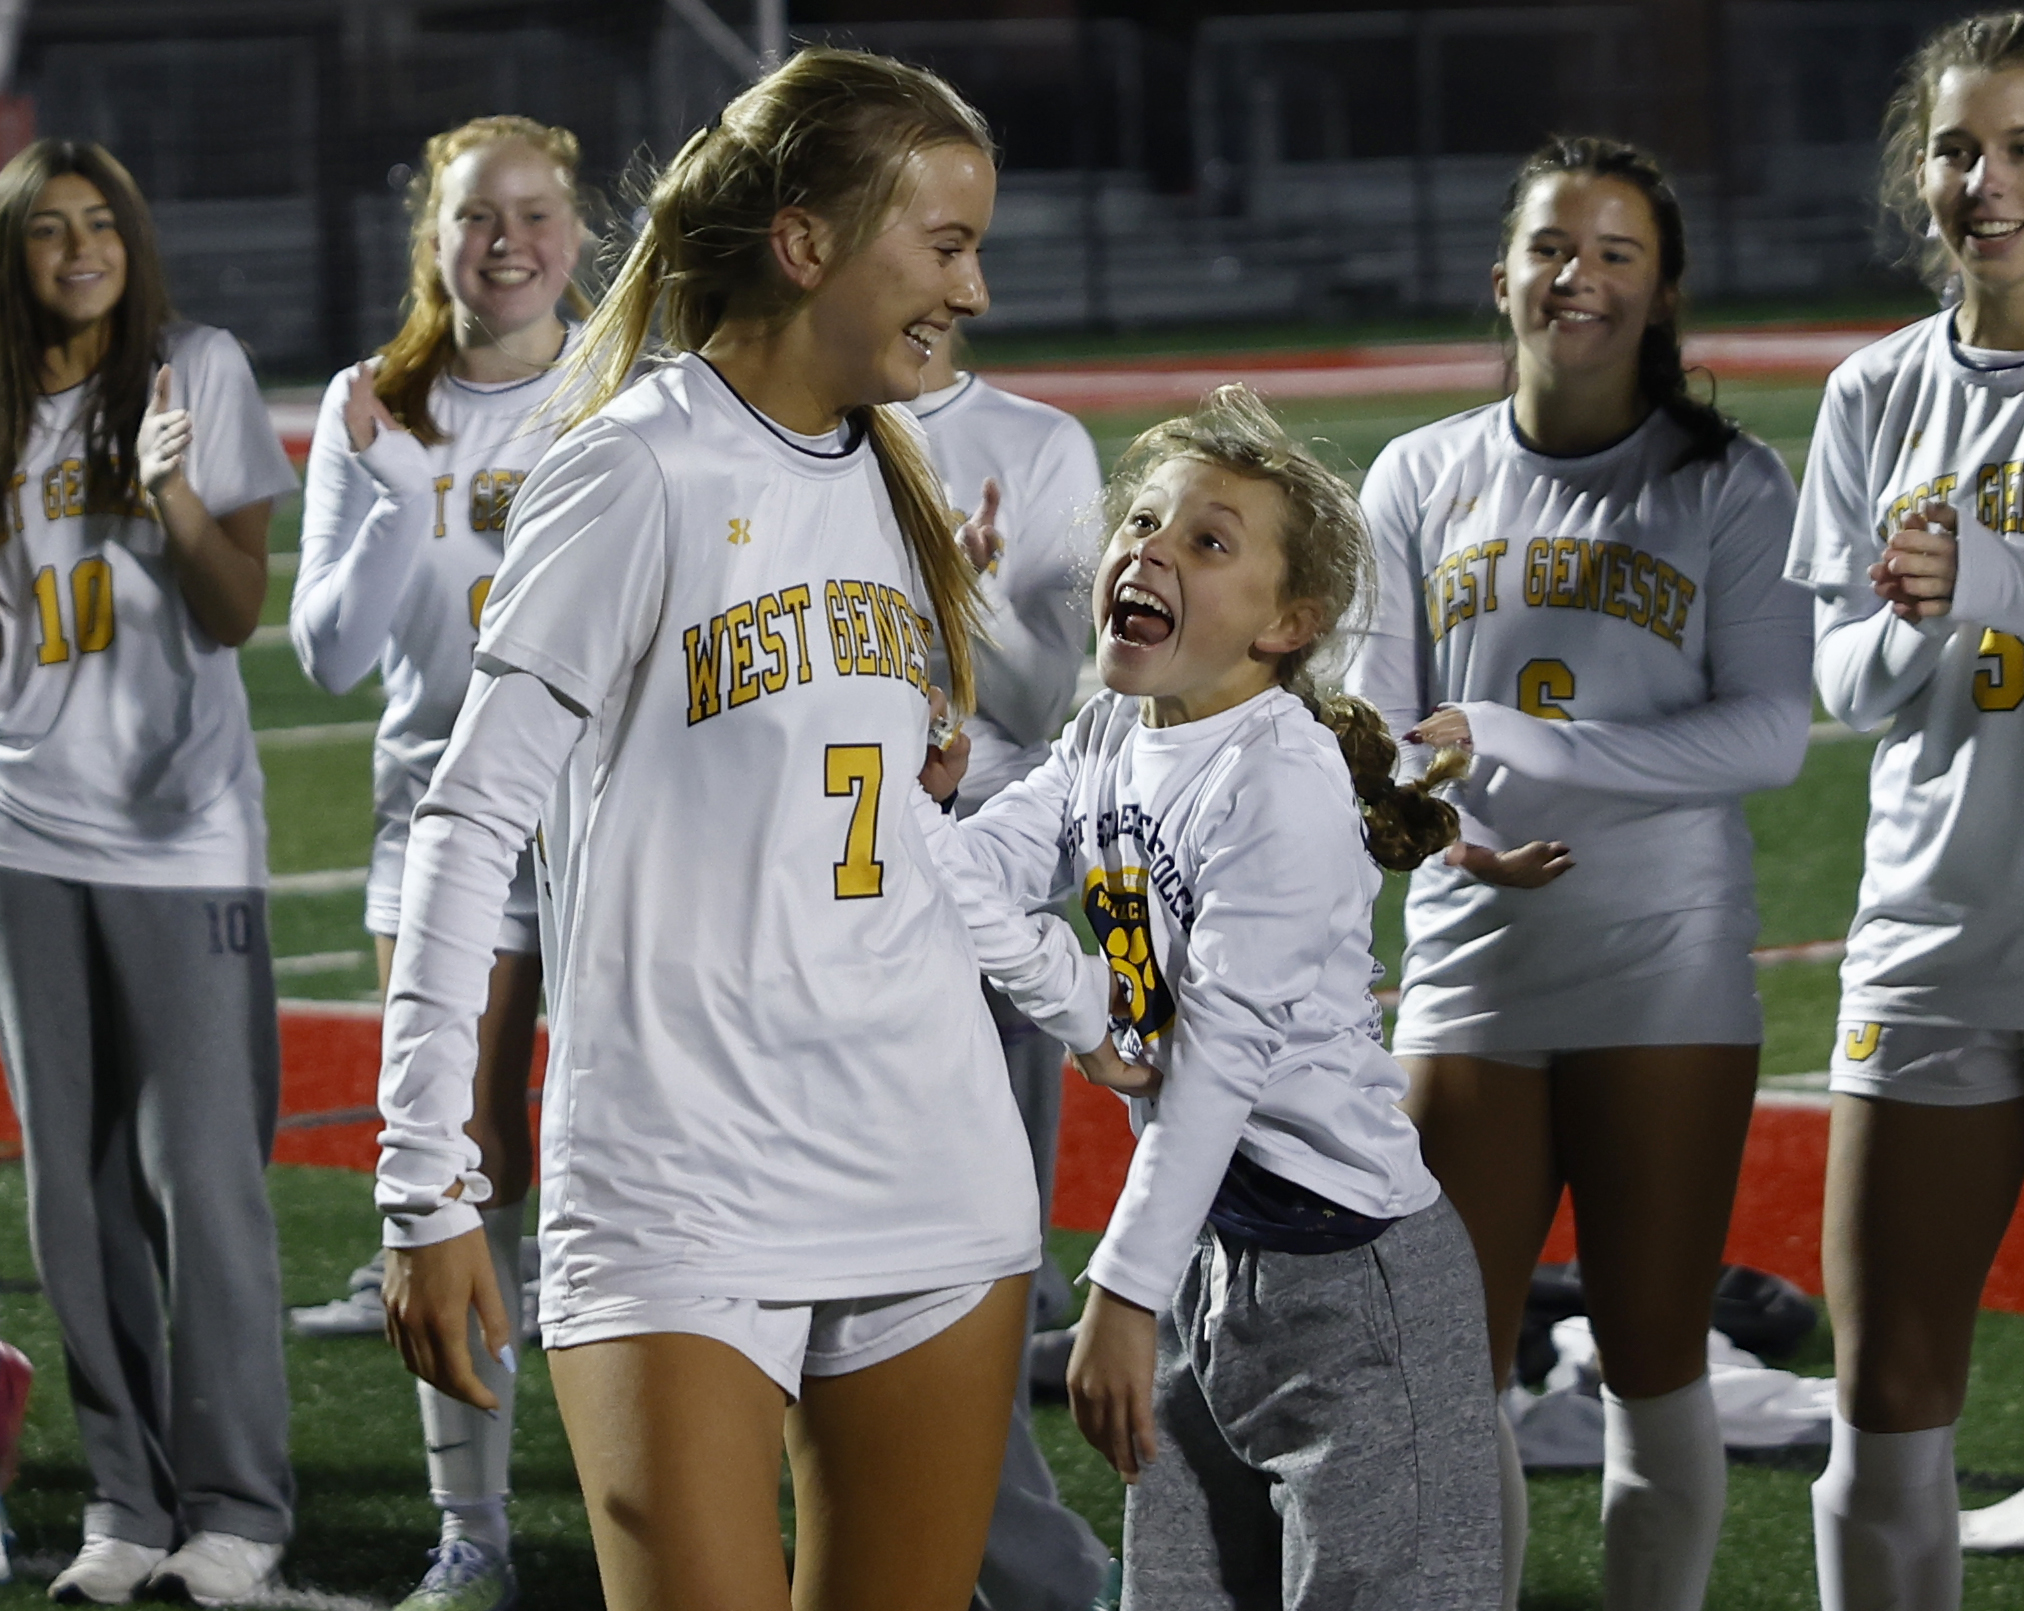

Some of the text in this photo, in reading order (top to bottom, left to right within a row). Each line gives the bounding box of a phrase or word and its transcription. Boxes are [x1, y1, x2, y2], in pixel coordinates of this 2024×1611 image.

[33, 554, 115, 666] 10
[1524, 537, 1696, 650] GENESEE
[682, 583, 812, 727] WEST
[824, 743, 883, 900] 7
[202, 901, 252, 955] 10
